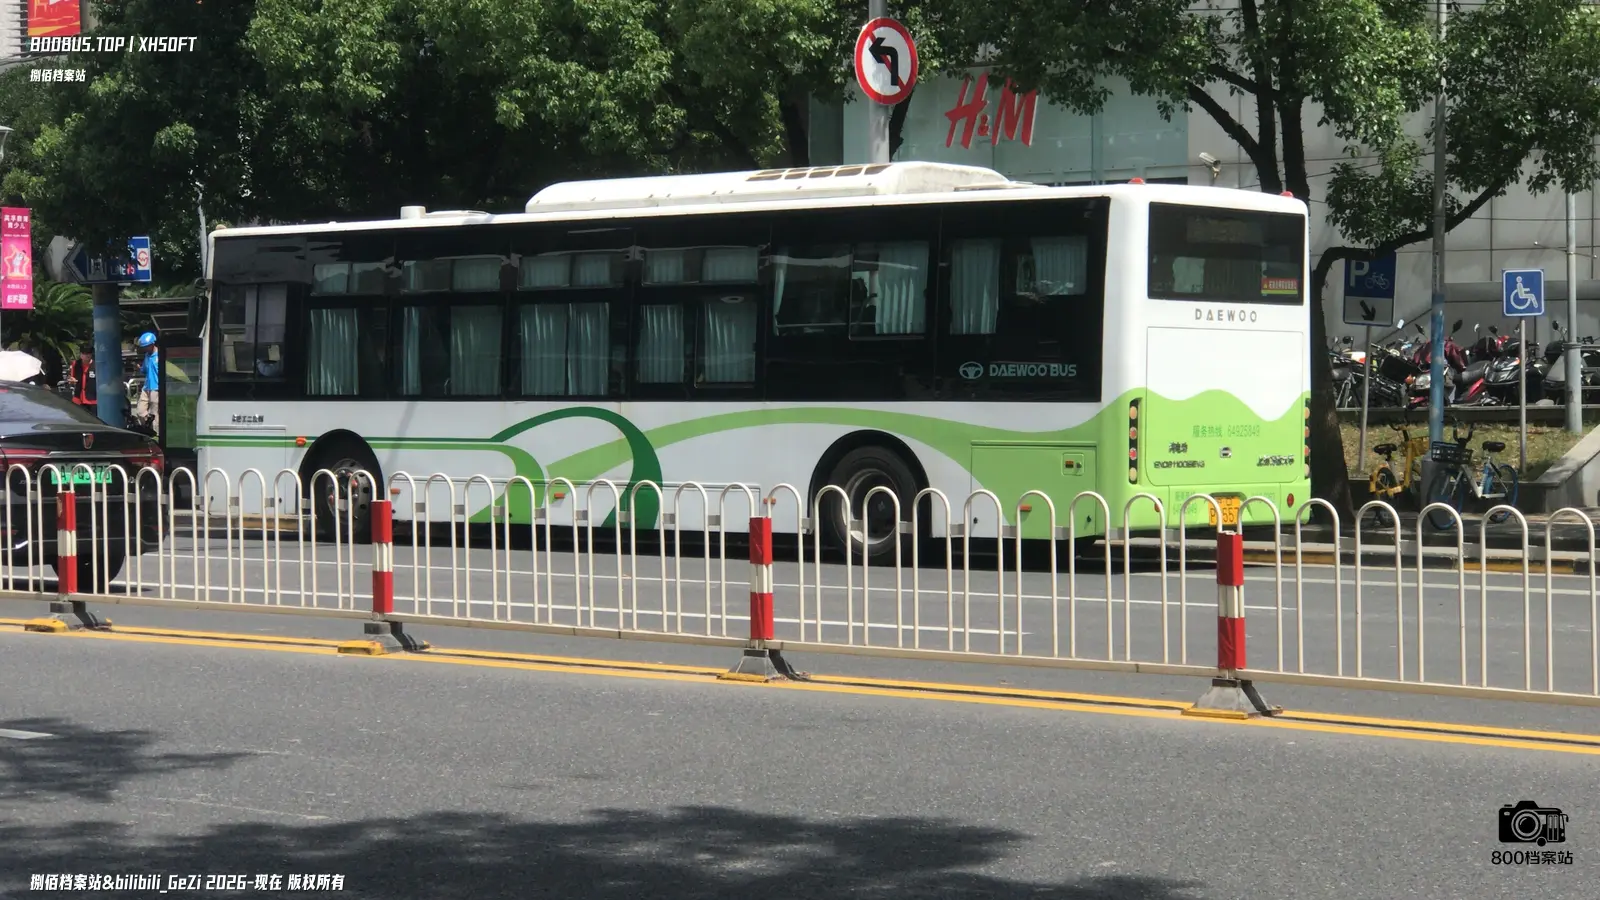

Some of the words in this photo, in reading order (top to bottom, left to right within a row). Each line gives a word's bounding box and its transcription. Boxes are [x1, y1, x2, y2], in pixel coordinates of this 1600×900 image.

[944, 70, 1039, 150] H&M
[1350, 259, 1370, 287] P
[1195, 308, 1257, 322] DAEWOO
[989, 364, 1047, 377] DAEWOO
[1049, 364, 1077, 377] BUS
[1192, 425, 1223, 438] 服务热线
